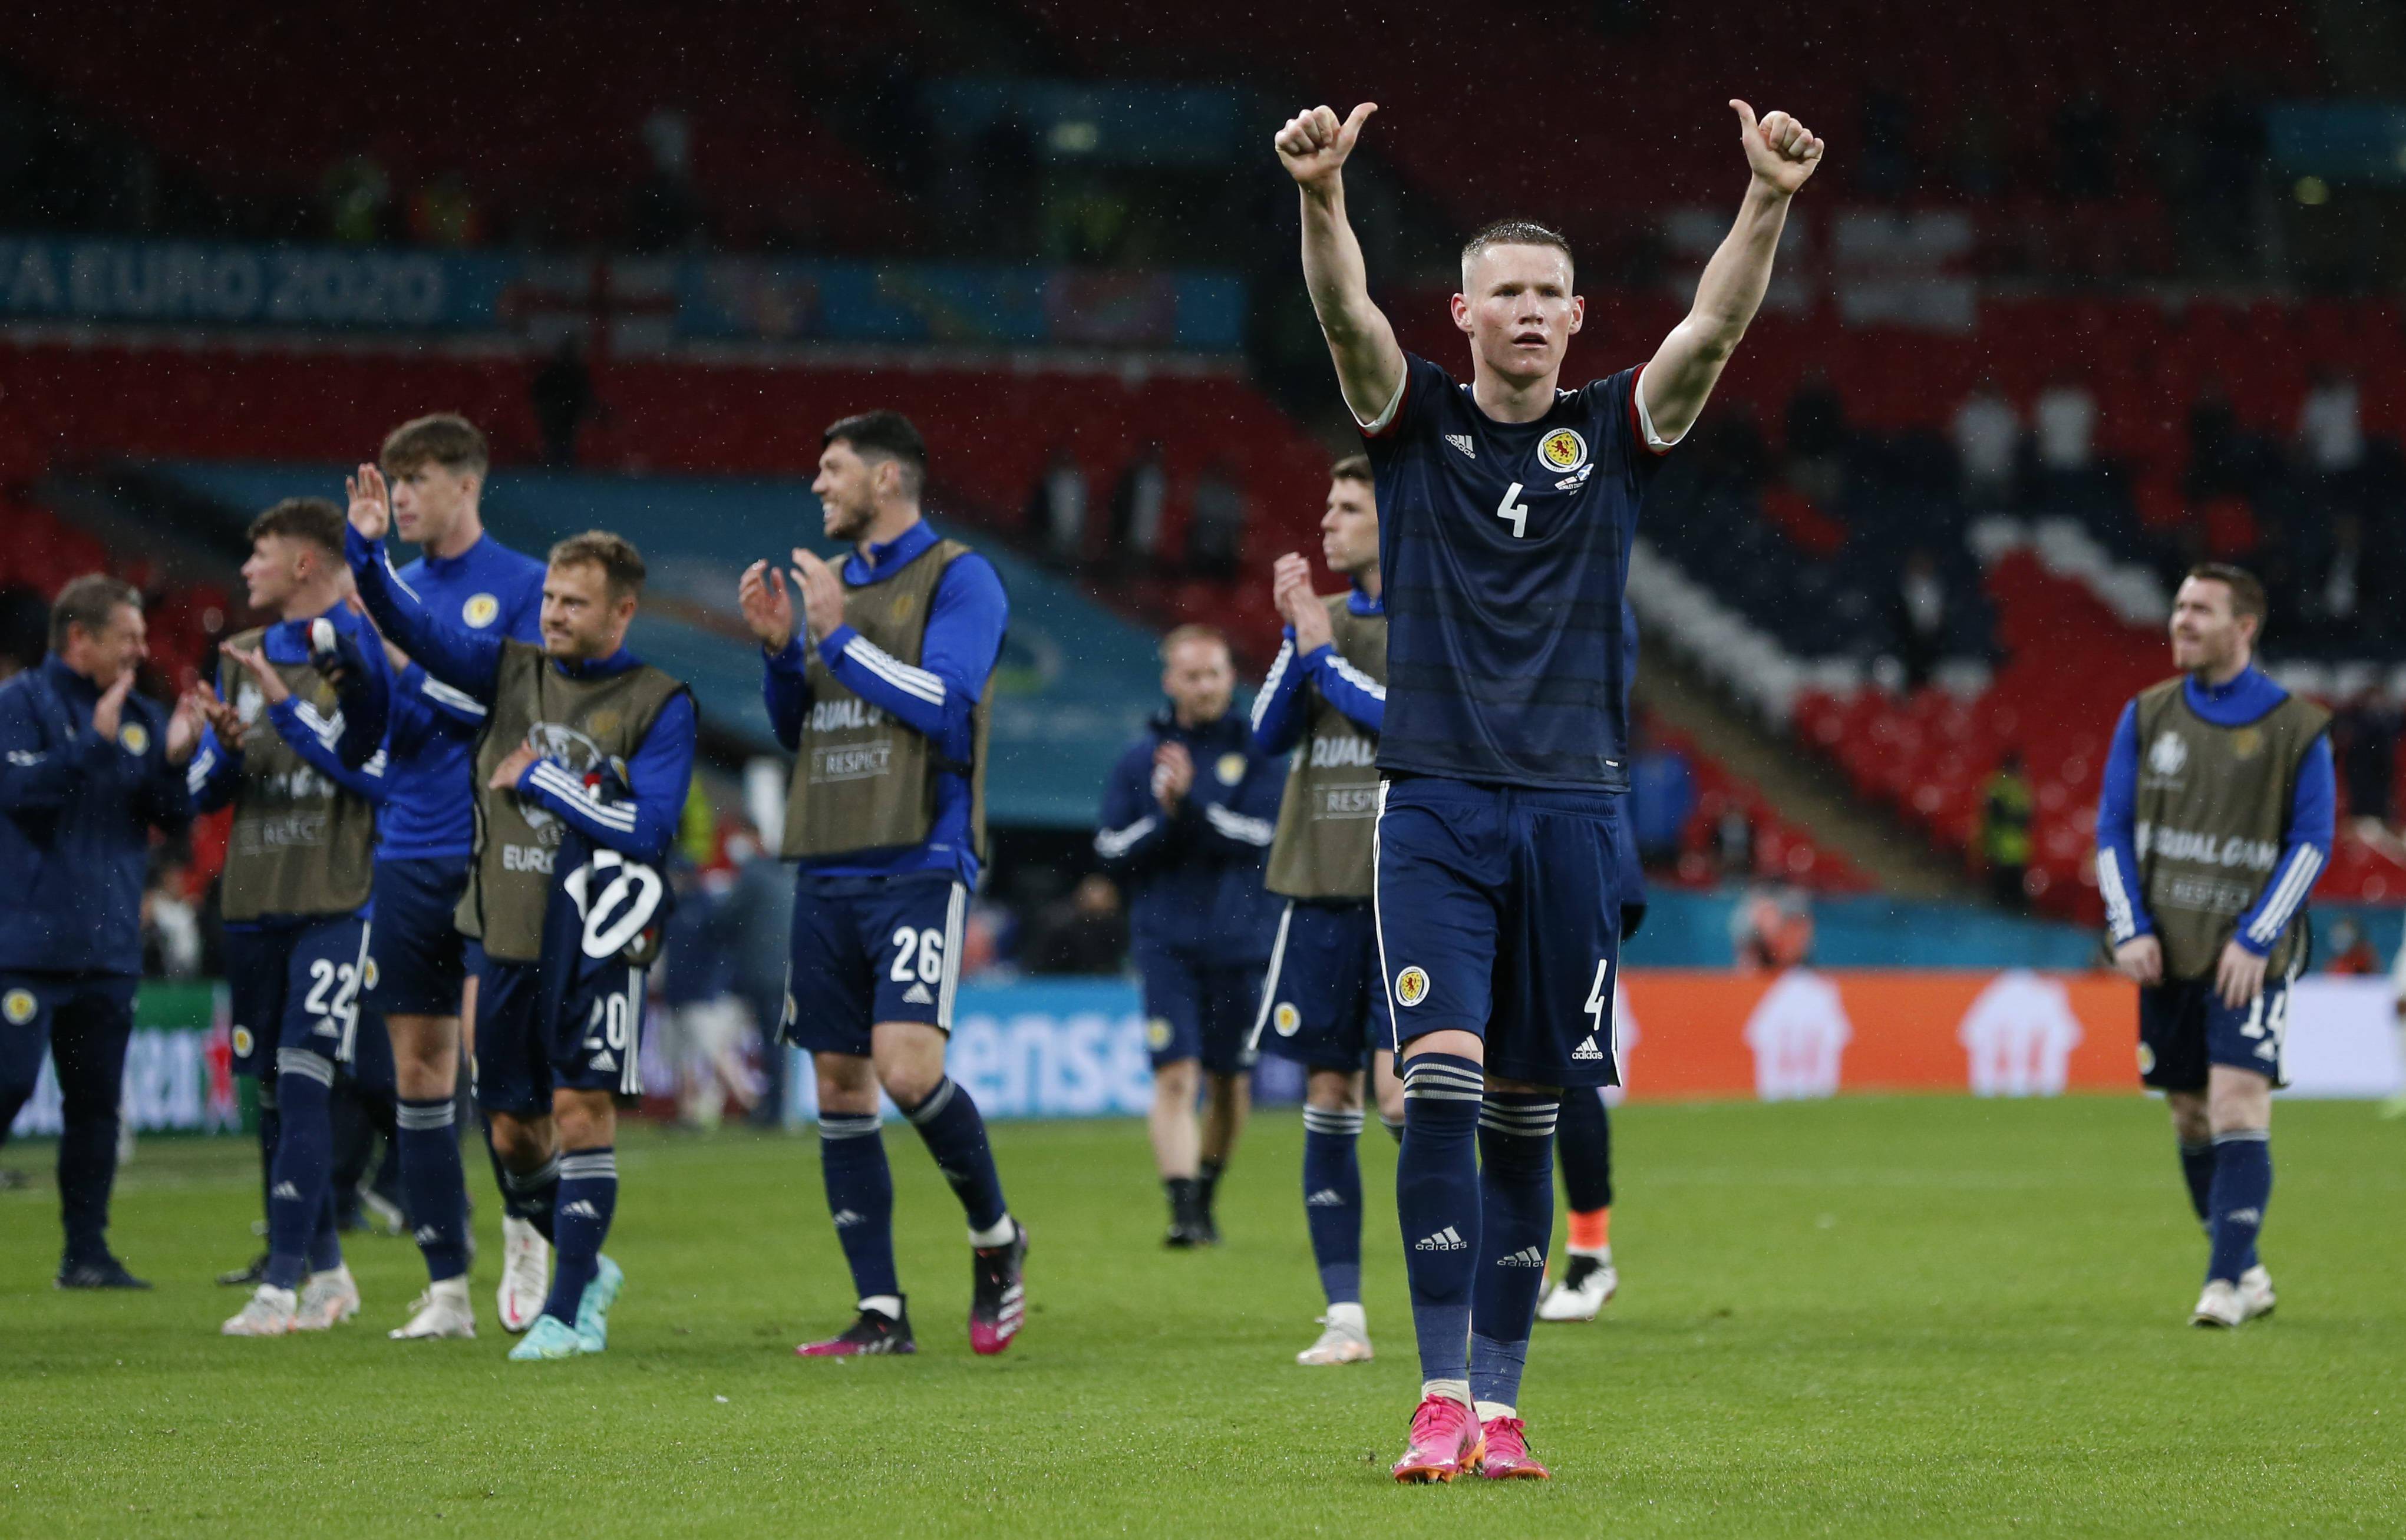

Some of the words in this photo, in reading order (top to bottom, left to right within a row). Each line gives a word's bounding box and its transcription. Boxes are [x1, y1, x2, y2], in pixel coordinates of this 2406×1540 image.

[71, 243, 261, 318] EURO
[269, 250, 444, 325] 2020
[1445, 434, 1476, 459] adidas
[1497, 482, 1528, 538] 4
[890, 926, 944, 984] 26
[303, 958, 357, 1019] 22
[1584, 959, 1607, 1031] 4
[2240, 990, 2286, 1040] 14
[582, 991, 628, 1050] 20
[1572, 1050, 1603, 1060] adidas
[1415, 1241, 1467, 1251] adidas
